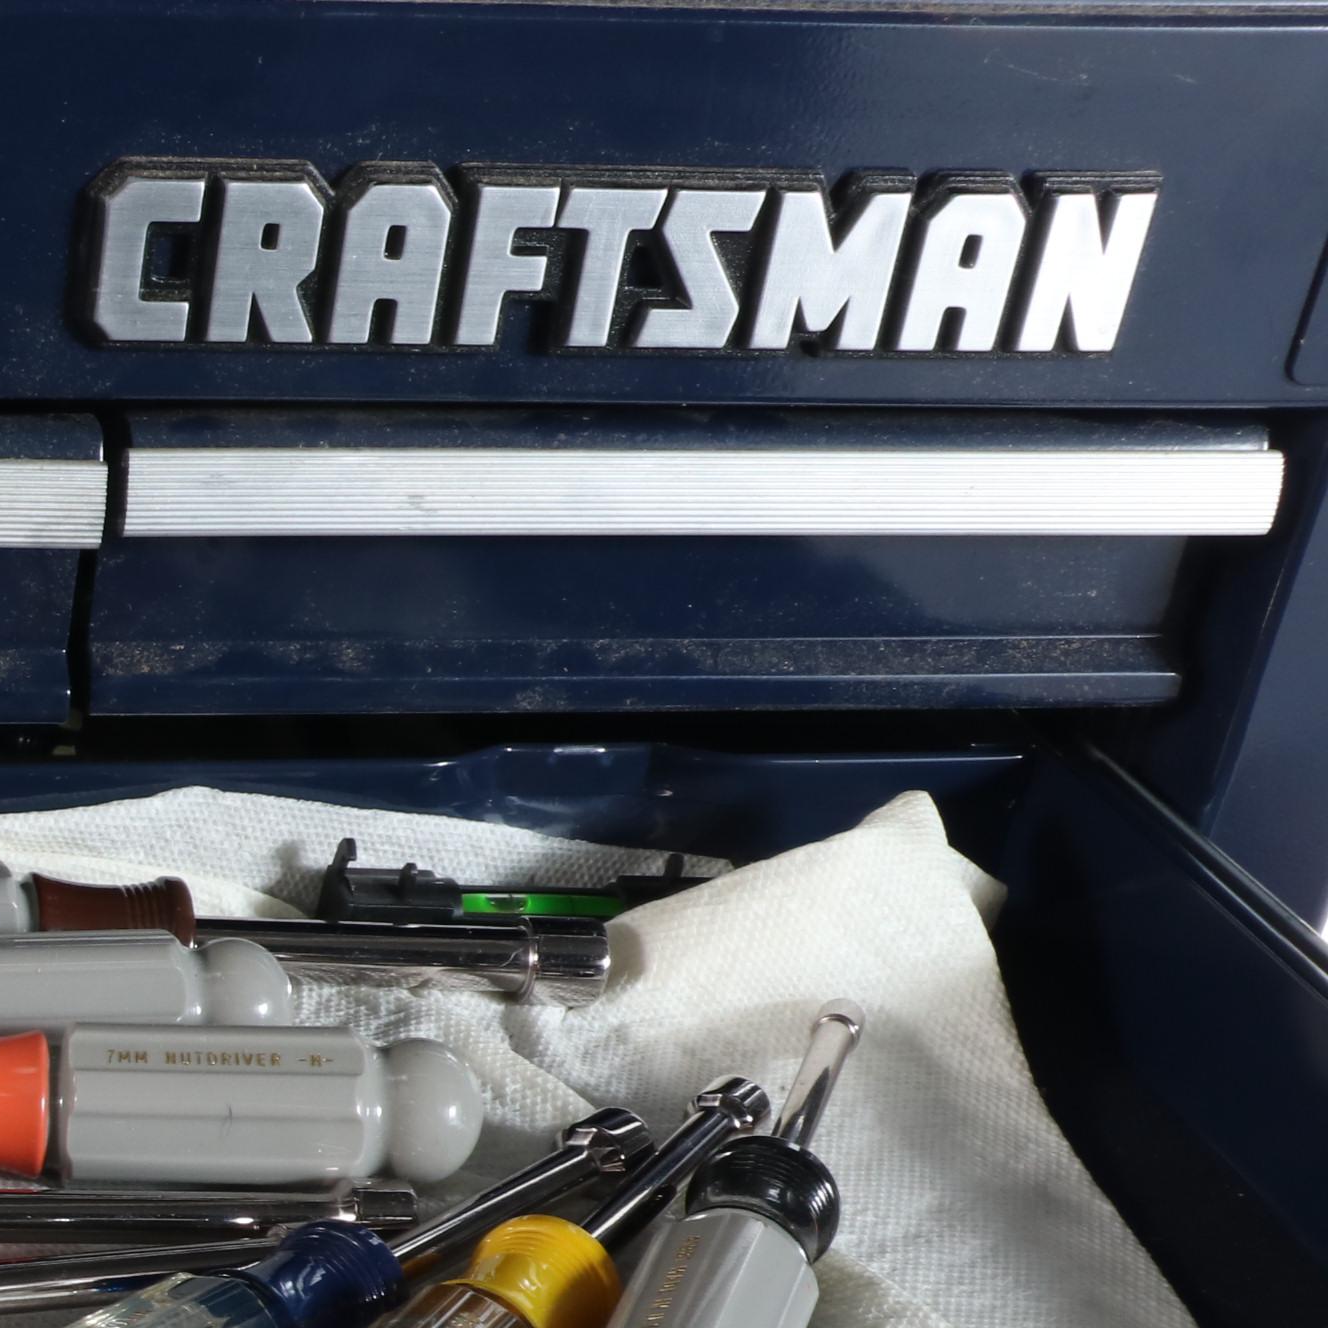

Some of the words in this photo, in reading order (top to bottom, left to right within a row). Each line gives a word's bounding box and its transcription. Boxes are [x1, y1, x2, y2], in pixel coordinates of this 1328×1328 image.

[90, 174, 1160, 354] CRAFTSMAN
[106, 1048, 150, 1065] 7MM
[163, 1049, 284, 1068] NUTDRIVER
